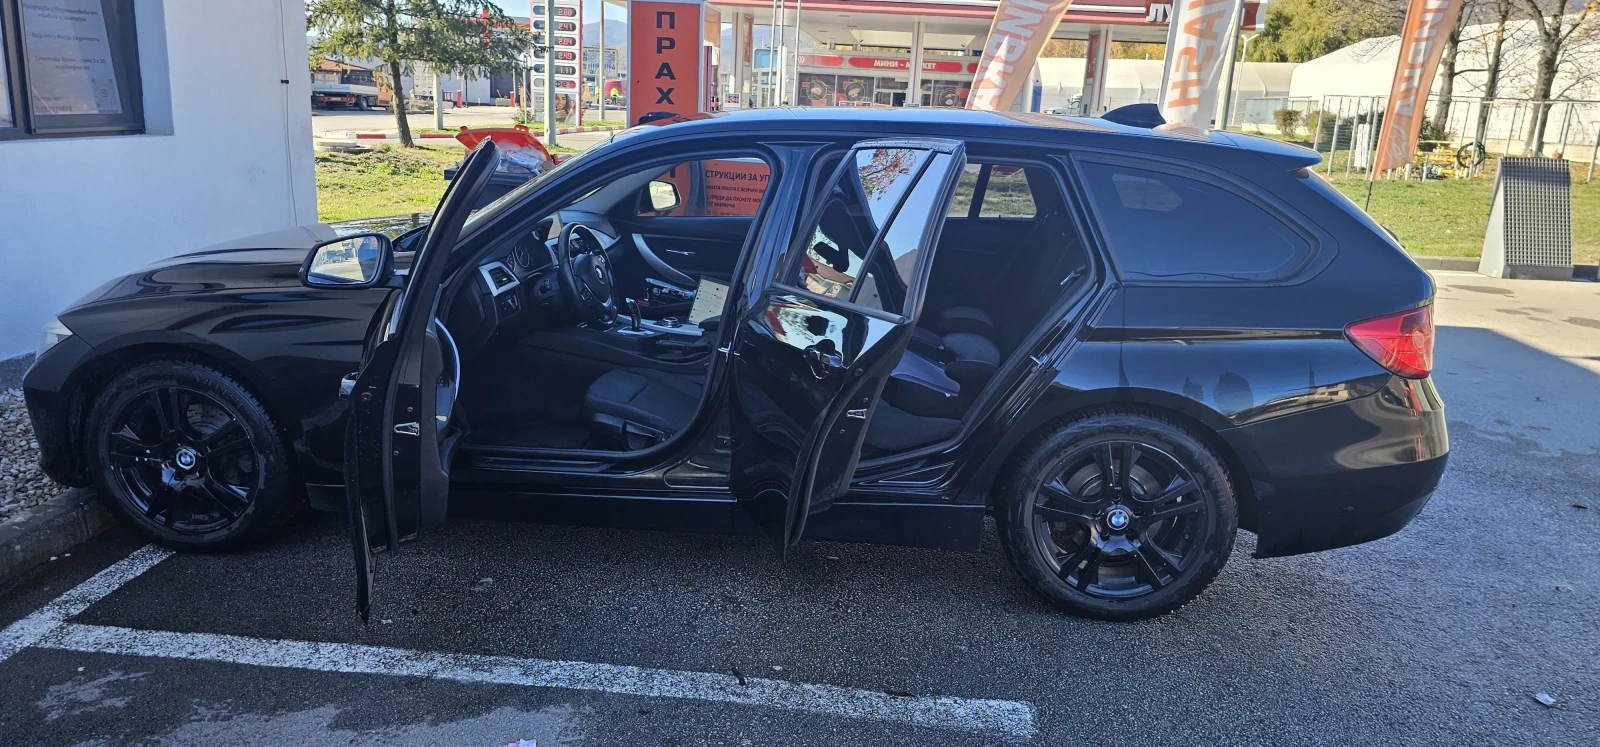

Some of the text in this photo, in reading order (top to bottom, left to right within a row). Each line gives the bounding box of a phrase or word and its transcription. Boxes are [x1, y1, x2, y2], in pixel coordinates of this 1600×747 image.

[655, 11, 676, 105] ПРАХ
[874, 59, 898, 68] МИНИ
[906, 62, 936, 70] МКЕТ
[706, 170, 746, 181] СТРУКЦИИ
[748, 174, 758, 182] ЗА
